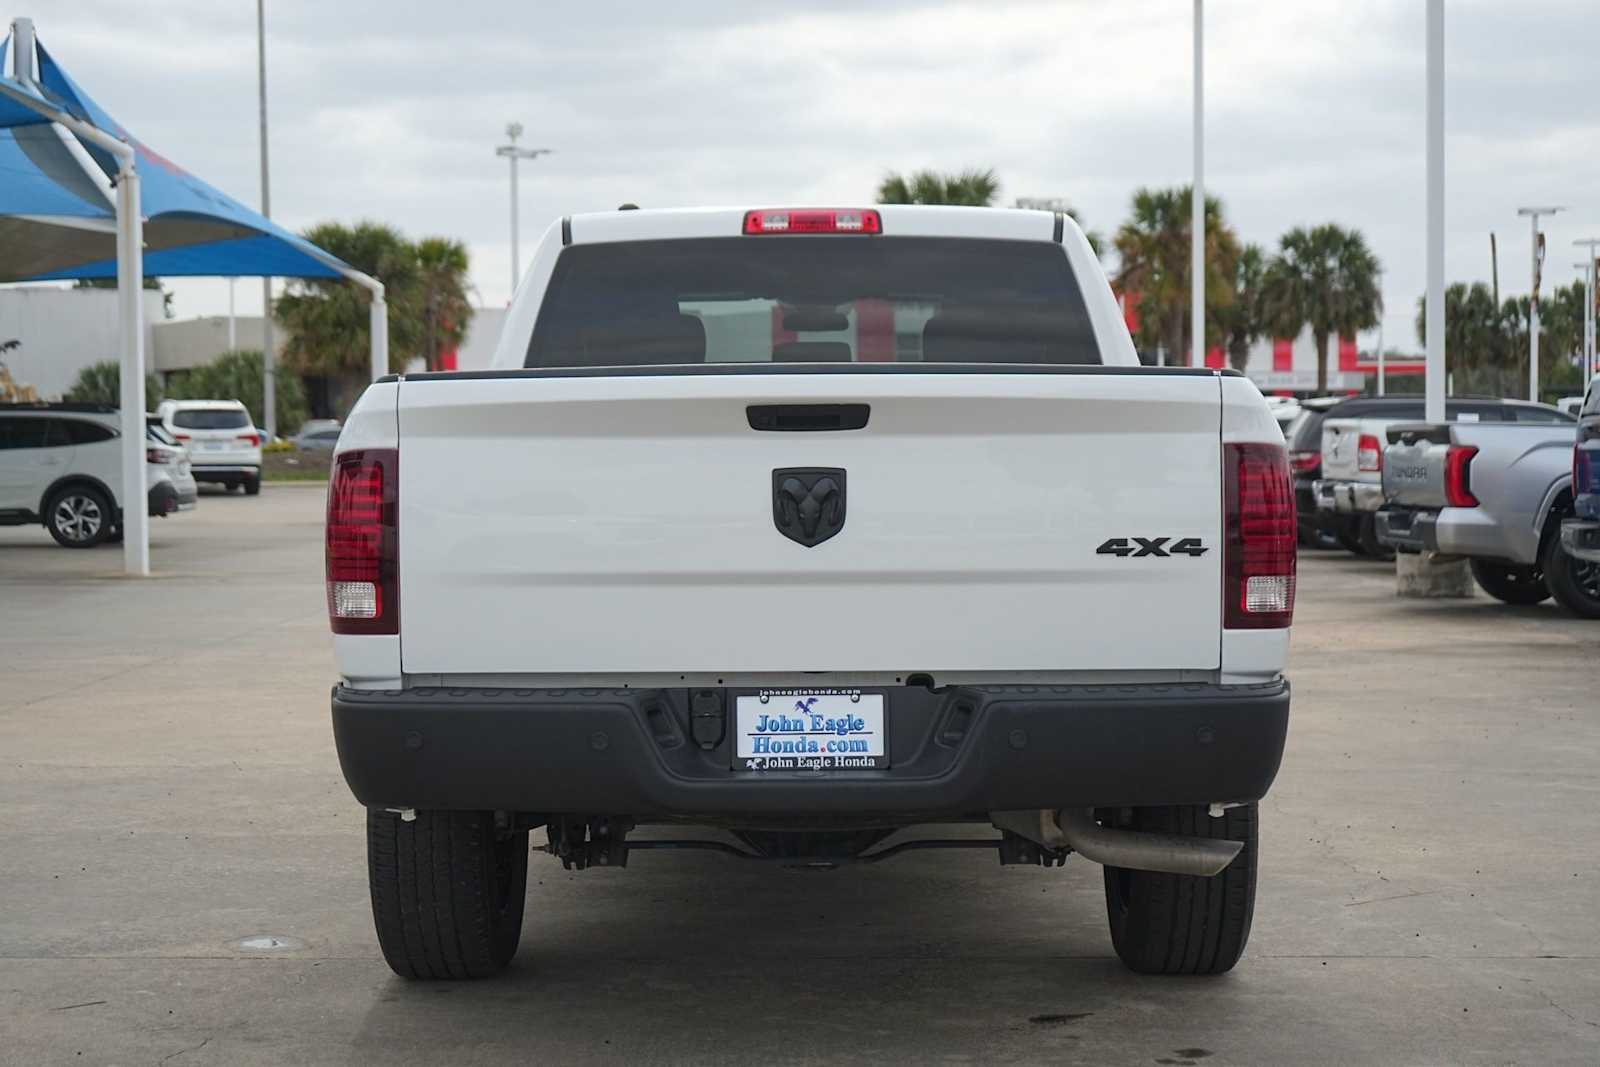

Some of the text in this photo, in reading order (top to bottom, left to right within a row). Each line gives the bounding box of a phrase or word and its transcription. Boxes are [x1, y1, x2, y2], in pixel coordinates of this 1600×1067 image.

[1096, 537, 1209, 557] 4X4
[756, 714, 865, 735] John Eagle
[752, 737, 868, 753] Honda.com
[763, 756, 876, 770] John Eagle Honda
